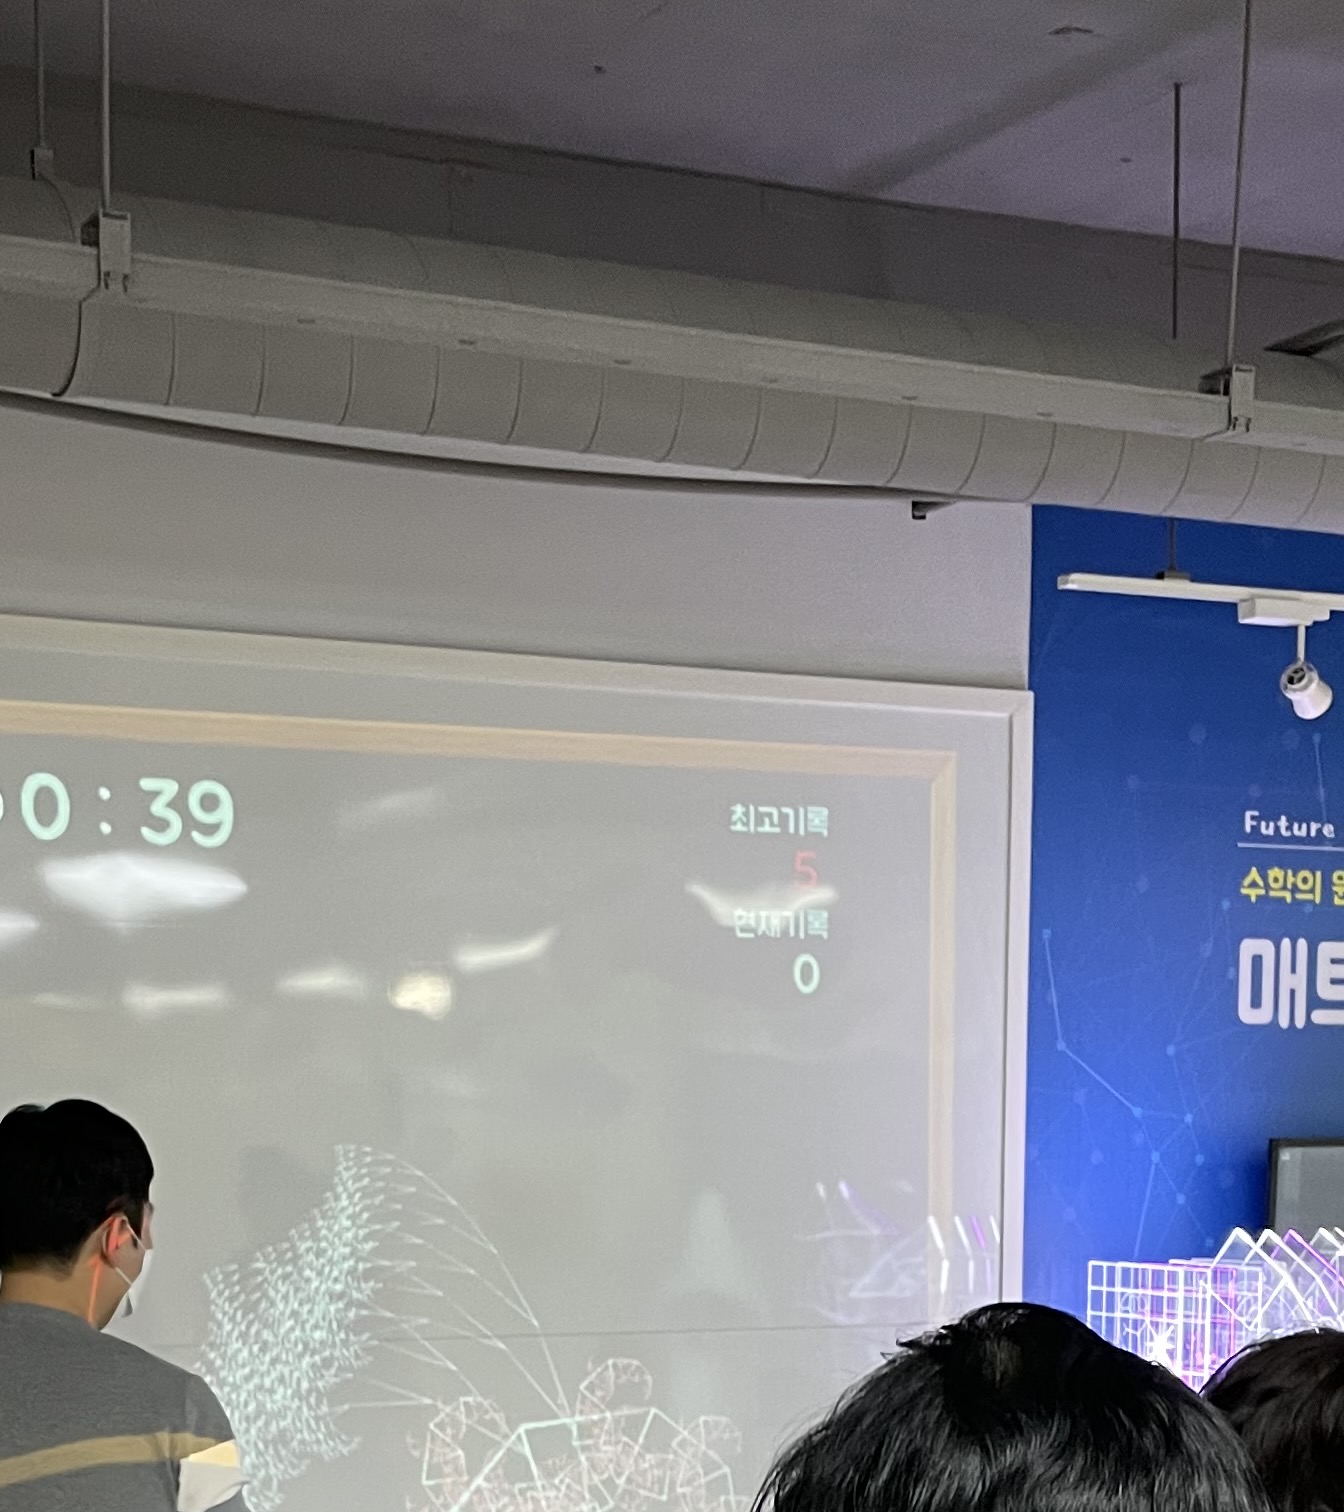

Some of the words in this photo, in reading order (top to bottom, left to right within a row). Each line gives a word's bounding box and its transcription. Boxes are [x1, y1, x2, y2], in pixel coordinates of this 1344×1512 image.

[730, 803, 828, 837] 최고기록
[1244, 811, 1335, 839] Future
[1239, 866, 1322, 904] 수학의
[793, 953, 820, 994] 0
